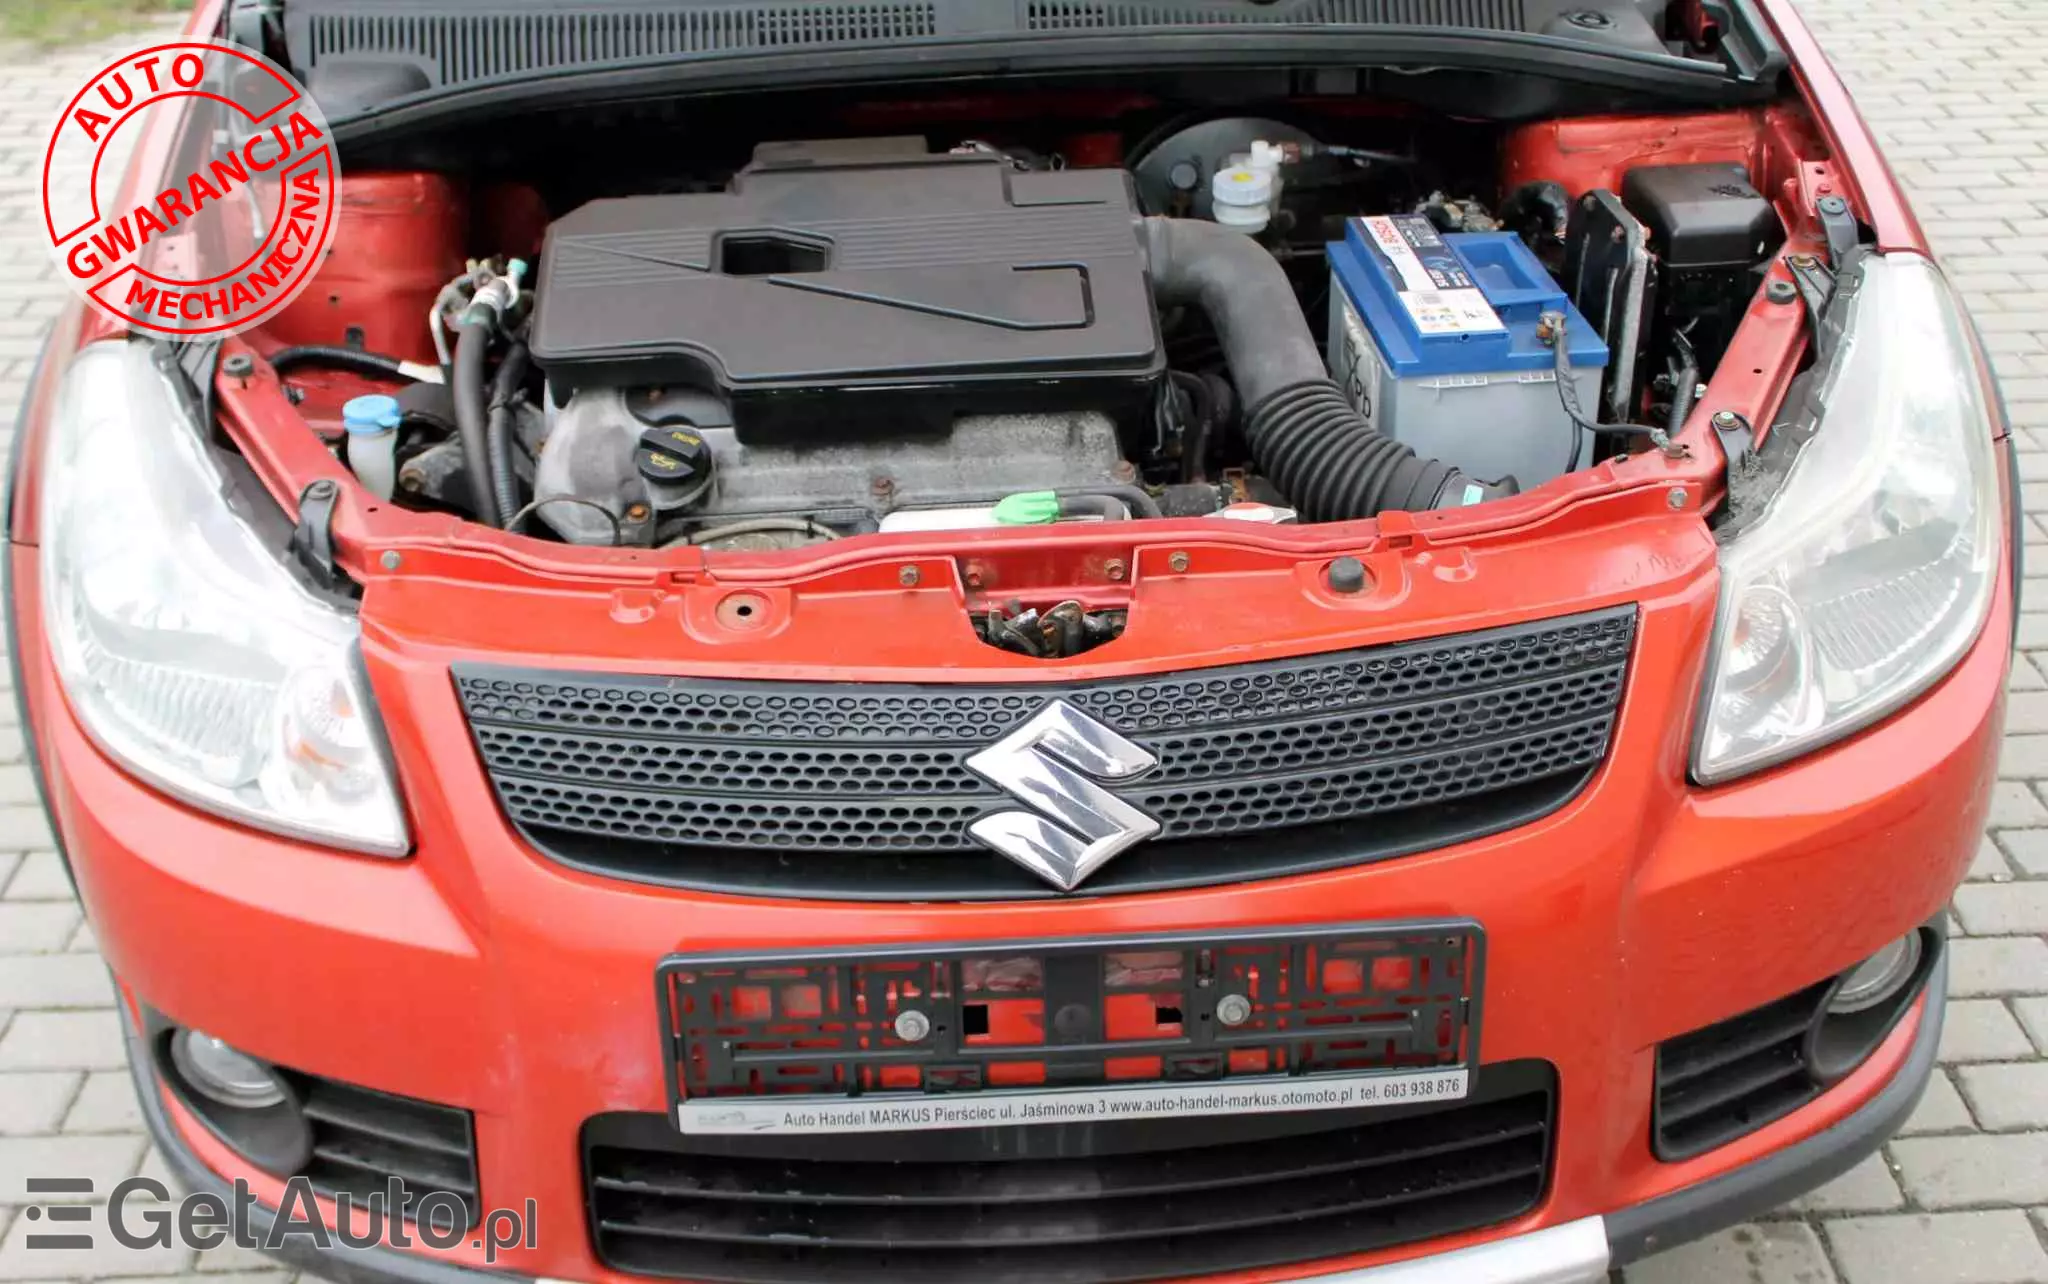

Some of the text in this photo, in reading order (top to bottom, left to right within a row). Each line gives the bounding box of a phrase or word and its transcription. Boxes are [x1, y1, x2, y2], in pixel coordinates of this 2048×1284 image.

[783, 1077, 1460, 1127] Auto Handel MARKUS Pierściec ul. Jaśminowa 3 www.auto-handel-markus.otomoto.pl tel. 603 938 876
